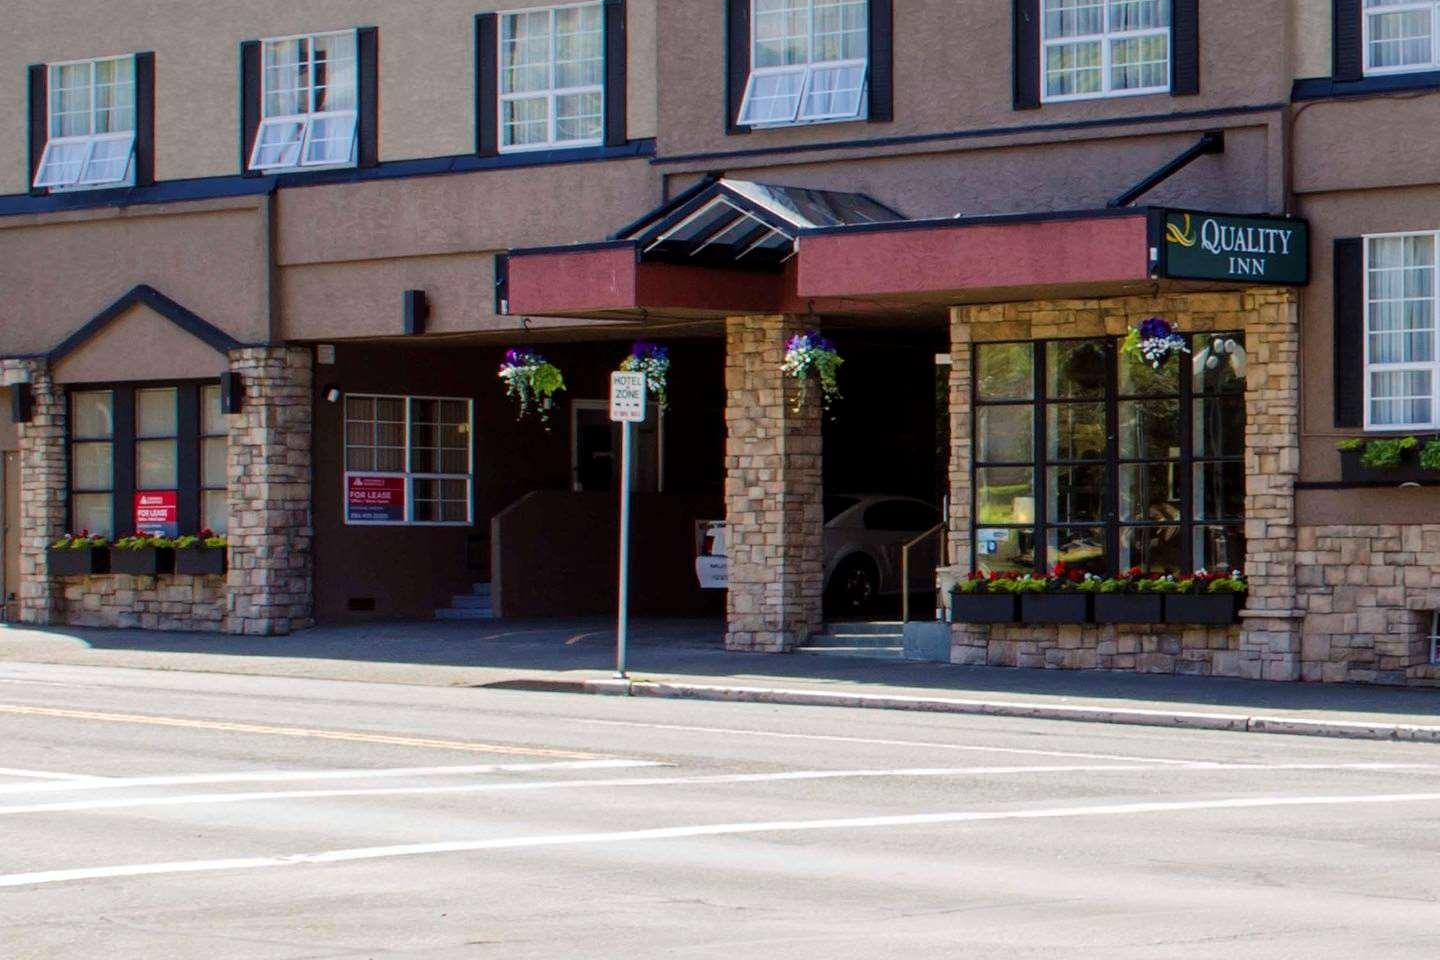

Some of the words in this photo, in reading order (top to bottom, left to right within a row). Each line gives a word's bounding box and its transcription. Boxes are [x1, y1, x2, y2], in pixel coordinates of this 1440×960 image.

[1201, 218, 1293, 255] QUALITY
[1228, 257, 1265, 275] INN
[350, 491, 366, 499] FOR
[367, 491, 392, 500] LEASE
